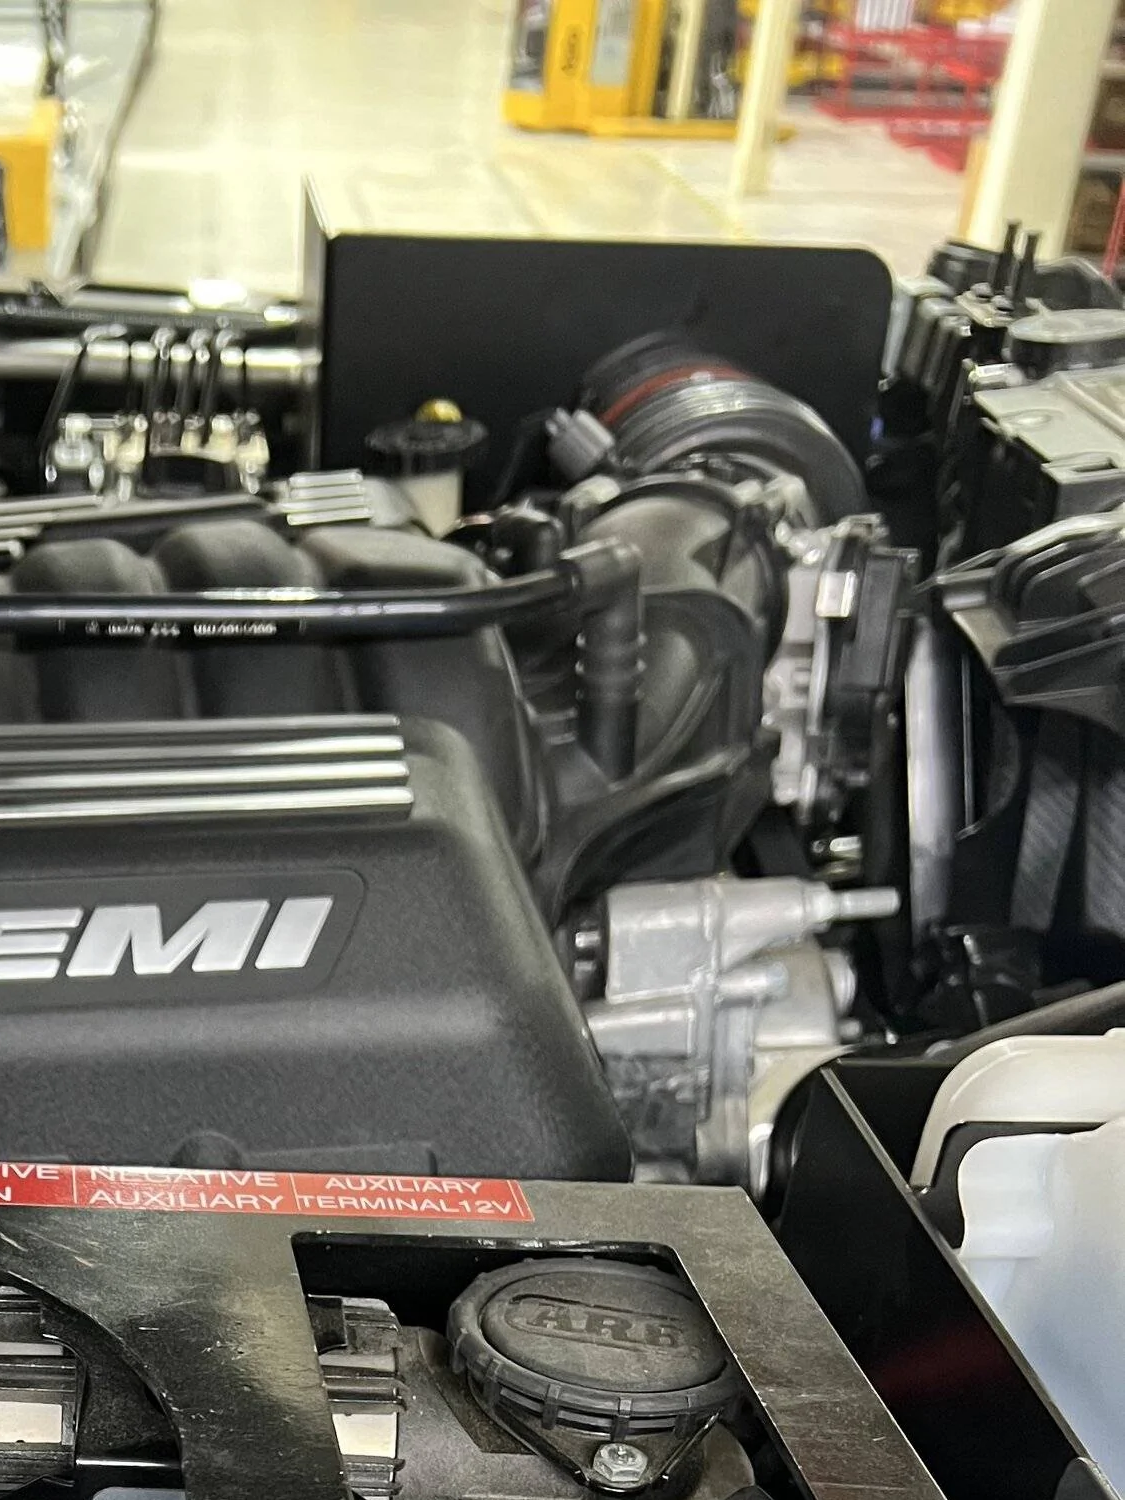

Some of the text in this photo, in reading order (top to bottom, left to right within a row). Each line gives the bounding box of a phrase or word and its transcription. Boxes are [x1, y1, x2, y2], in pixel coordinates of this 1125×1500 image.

[89, 1166, 279, 1187] NEGATIVE
[324, 1176, 483, 1195] AUXILIARY
[88, 1189, 284, 1210] AUXILIARY
[526, 1301, 683, 1348] ARB
